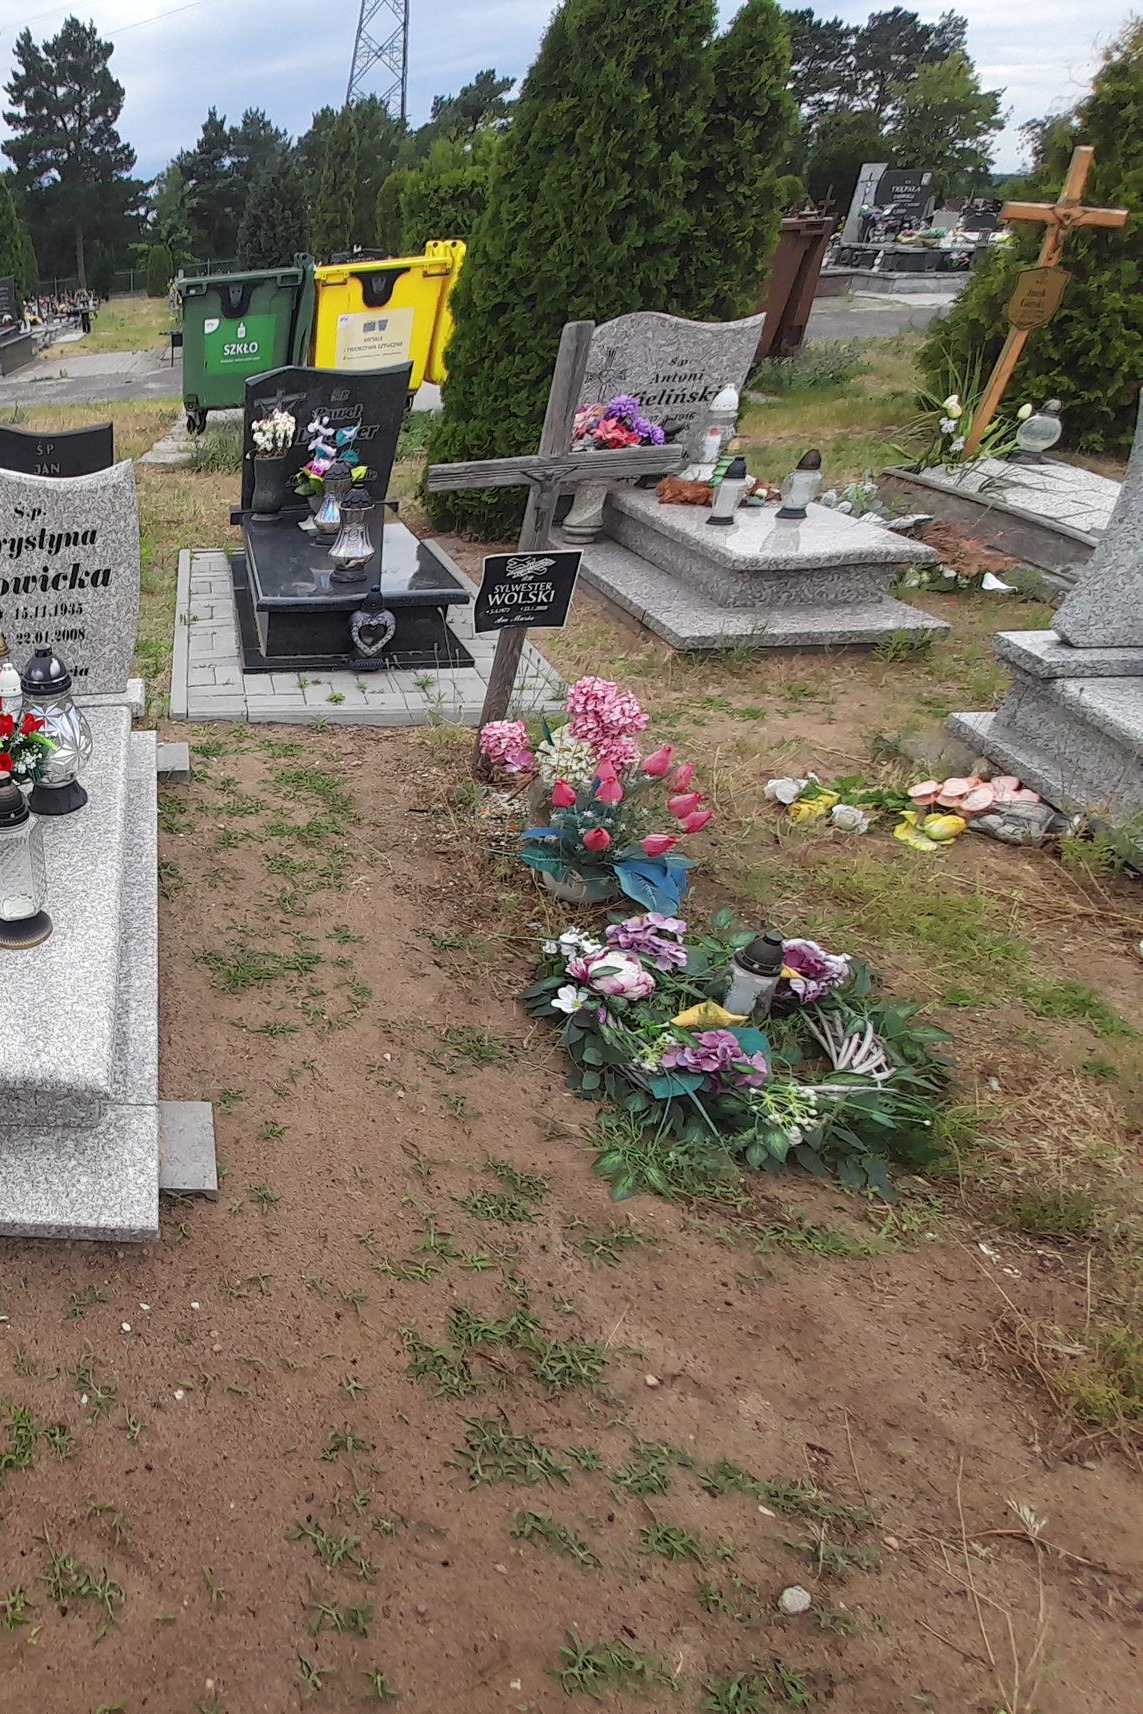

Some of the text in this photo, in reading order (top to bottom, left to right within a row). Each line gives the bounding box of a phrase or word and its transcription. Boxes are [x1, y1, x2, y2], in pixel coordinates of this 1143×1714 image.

[223, 341, 259, 356] SZKŁO
[33, 462, 61, 475] JAN
[493, 582, 553, 594] SYLWESTER
[487, 589, 556, 607] WOLSKI
